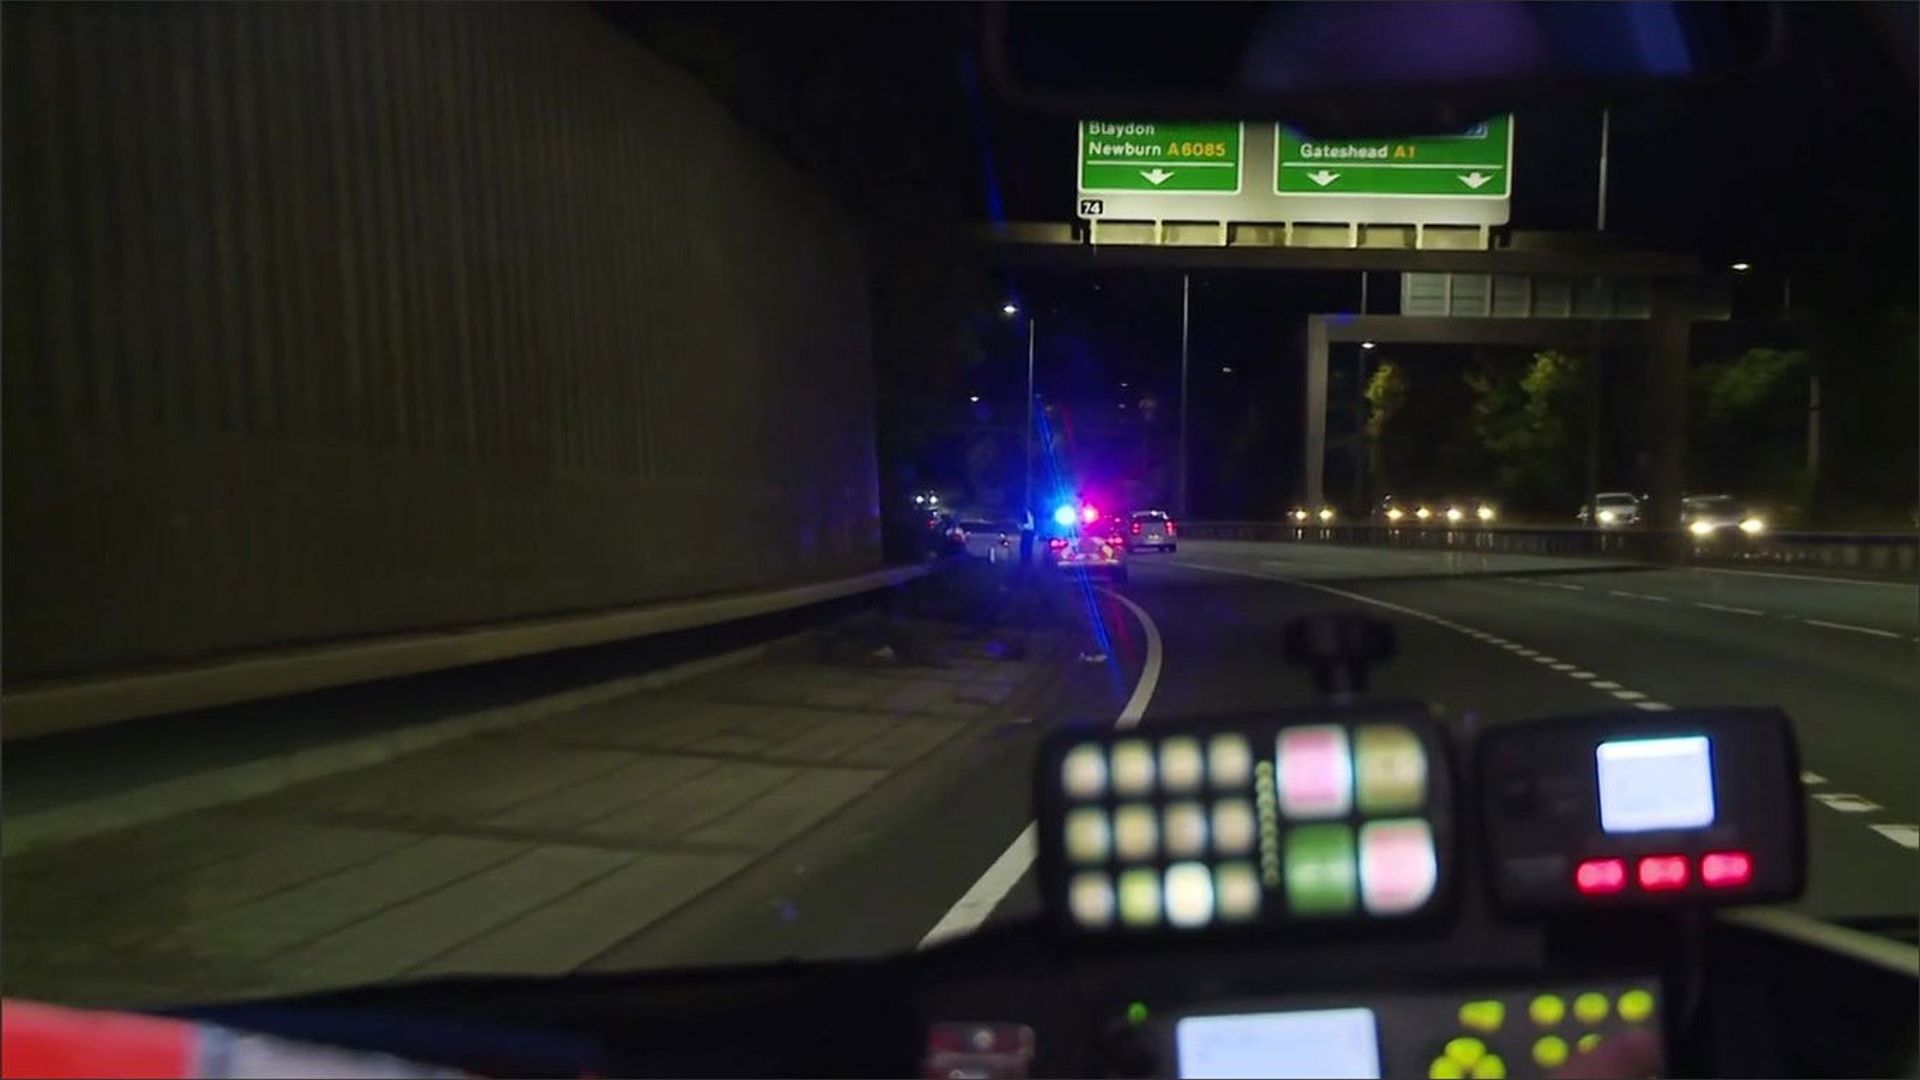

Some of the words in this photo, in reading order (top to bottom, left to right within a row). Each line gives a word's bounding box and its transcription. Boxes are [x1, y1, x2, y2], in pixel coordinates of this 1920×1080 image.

[1089, 122, 1155, 137] Blaydon
[1089, 142, 1161, 156] Newburn
[1167, 142, 1226, 157] A6085
[1300, 143, 1388, 159] Gateshead
[1394, 145, 1416, 158] A1
[1083, 202, 1101, 215] 74
